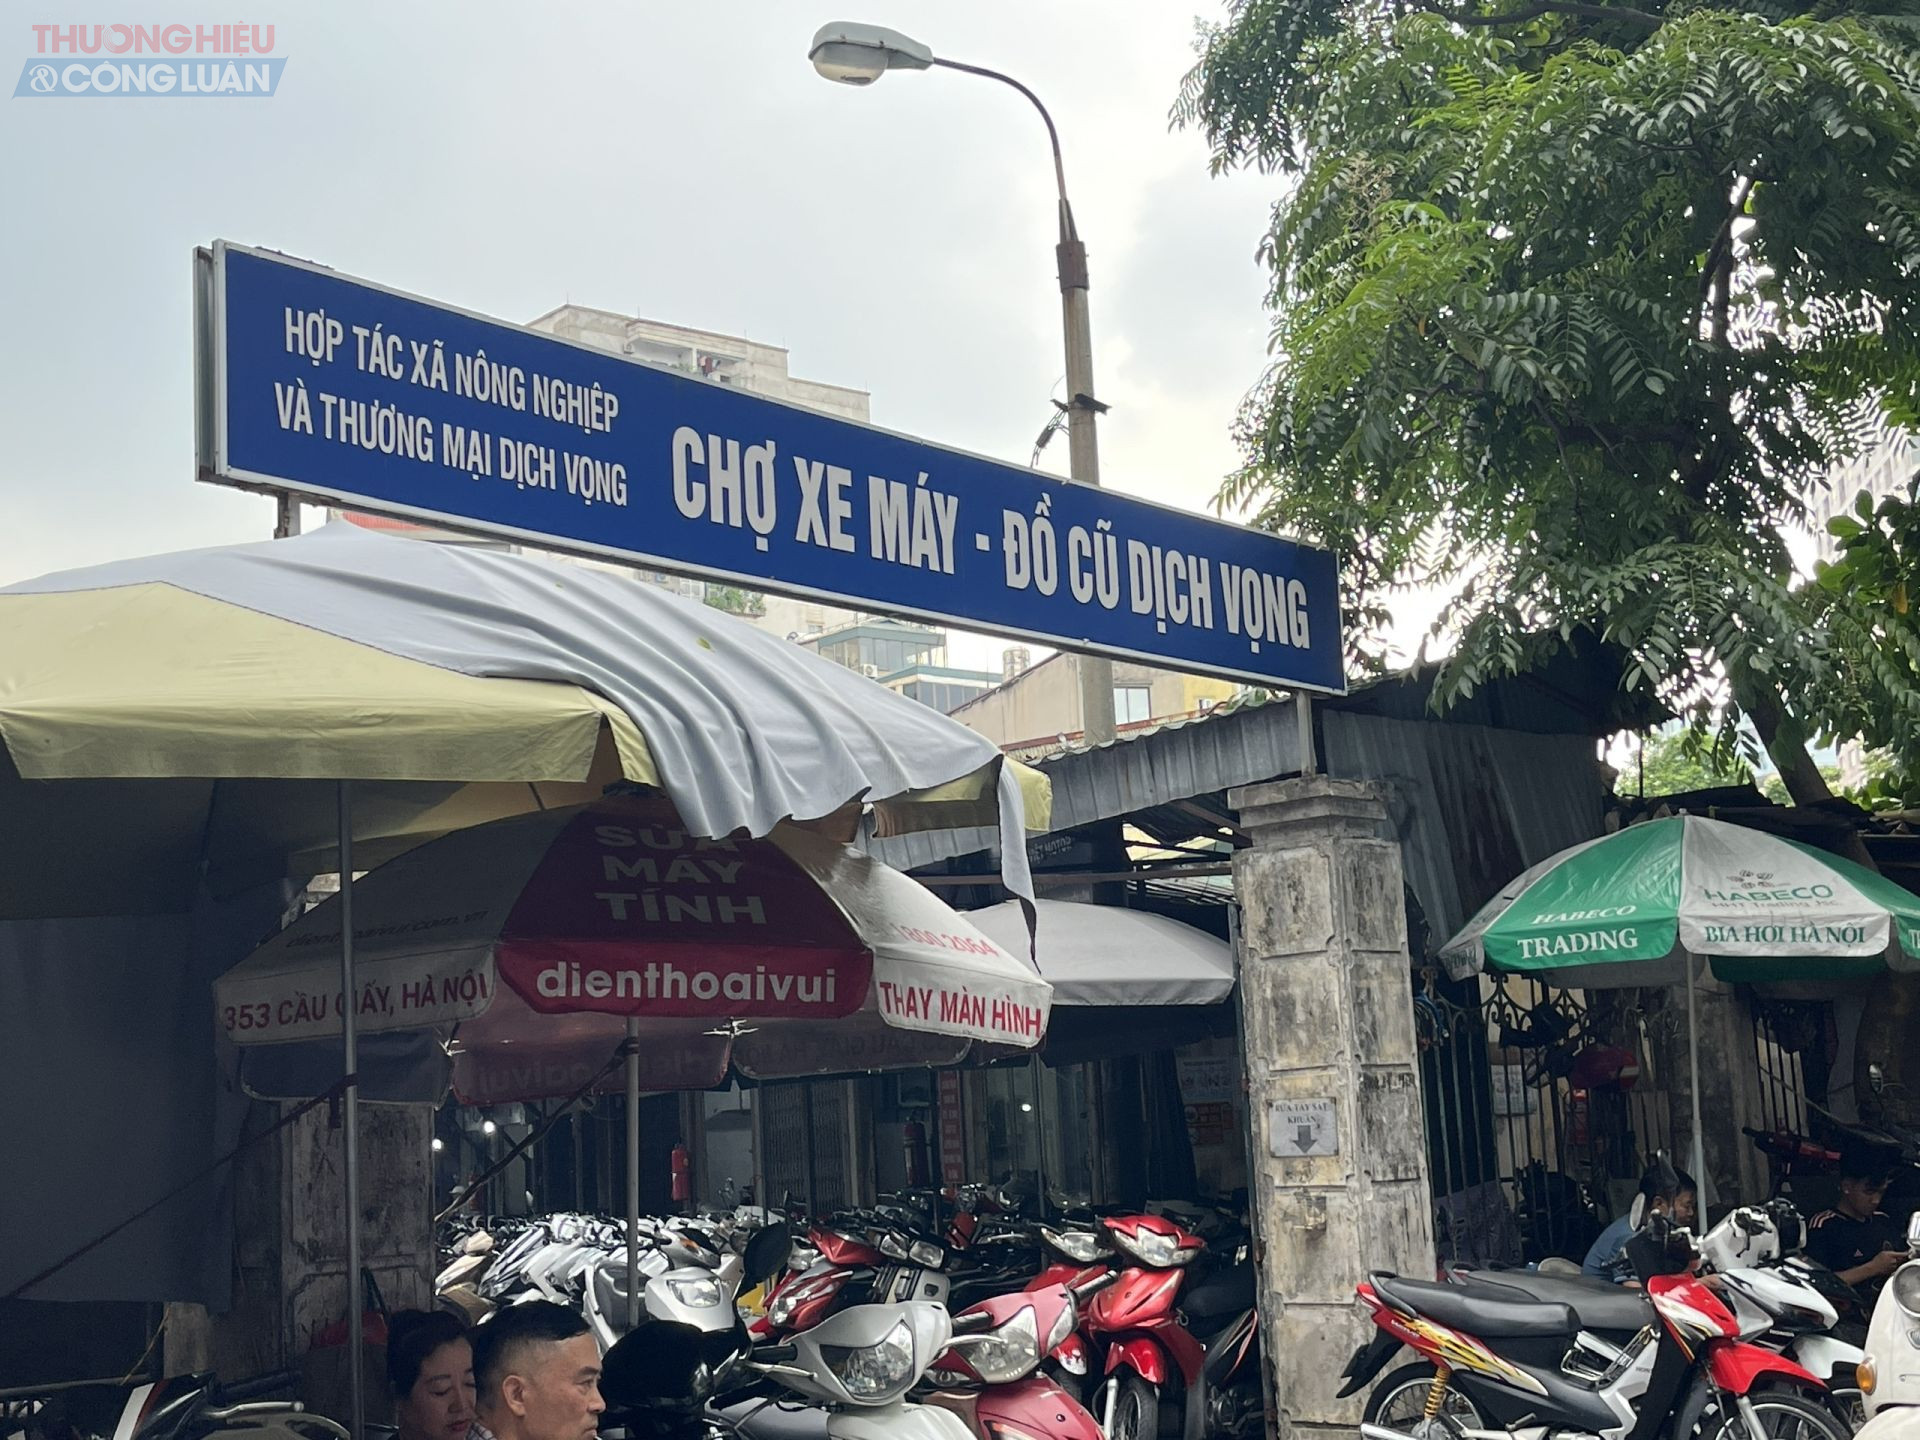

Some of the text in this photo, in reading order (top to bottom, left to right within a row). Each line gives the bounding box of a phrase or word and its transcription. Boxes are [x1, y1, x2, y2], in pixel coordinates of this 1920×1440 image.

[285, 307, 620, 434] HỢP TÁC XÃ NÔNG NGHIỆP
[274, 377, 628, 507] VÀ THƯƠNG MẠI DỊCH VỌNG
[671, 426, 1311, 655] CHỢ XE MÁY - ĐỒ CŨ DỊCH VỌNG
[602, 854, 743, 884] MÁY
[593, 887, 768, 925] TÍNH
[1703, 884, 1834, 901] HABECO
[1530, 905, 1637, 925] HABECO
[1705, 921, 1866, 948] BIA HƠI HÀ NỘI
[1517, 928, 1638, 959] TRADING
[225, 1003, 271, 1031] 353
[278, 991, 327, 1025] CẦU
[402, 975, 436, 1009] HÀ
[443, 968, 488, 1007] NỘI
[536, 961, 836, 1003] dienthoaivui
[879, 982, 1042, 1039] THAY MÀN HÌNH
